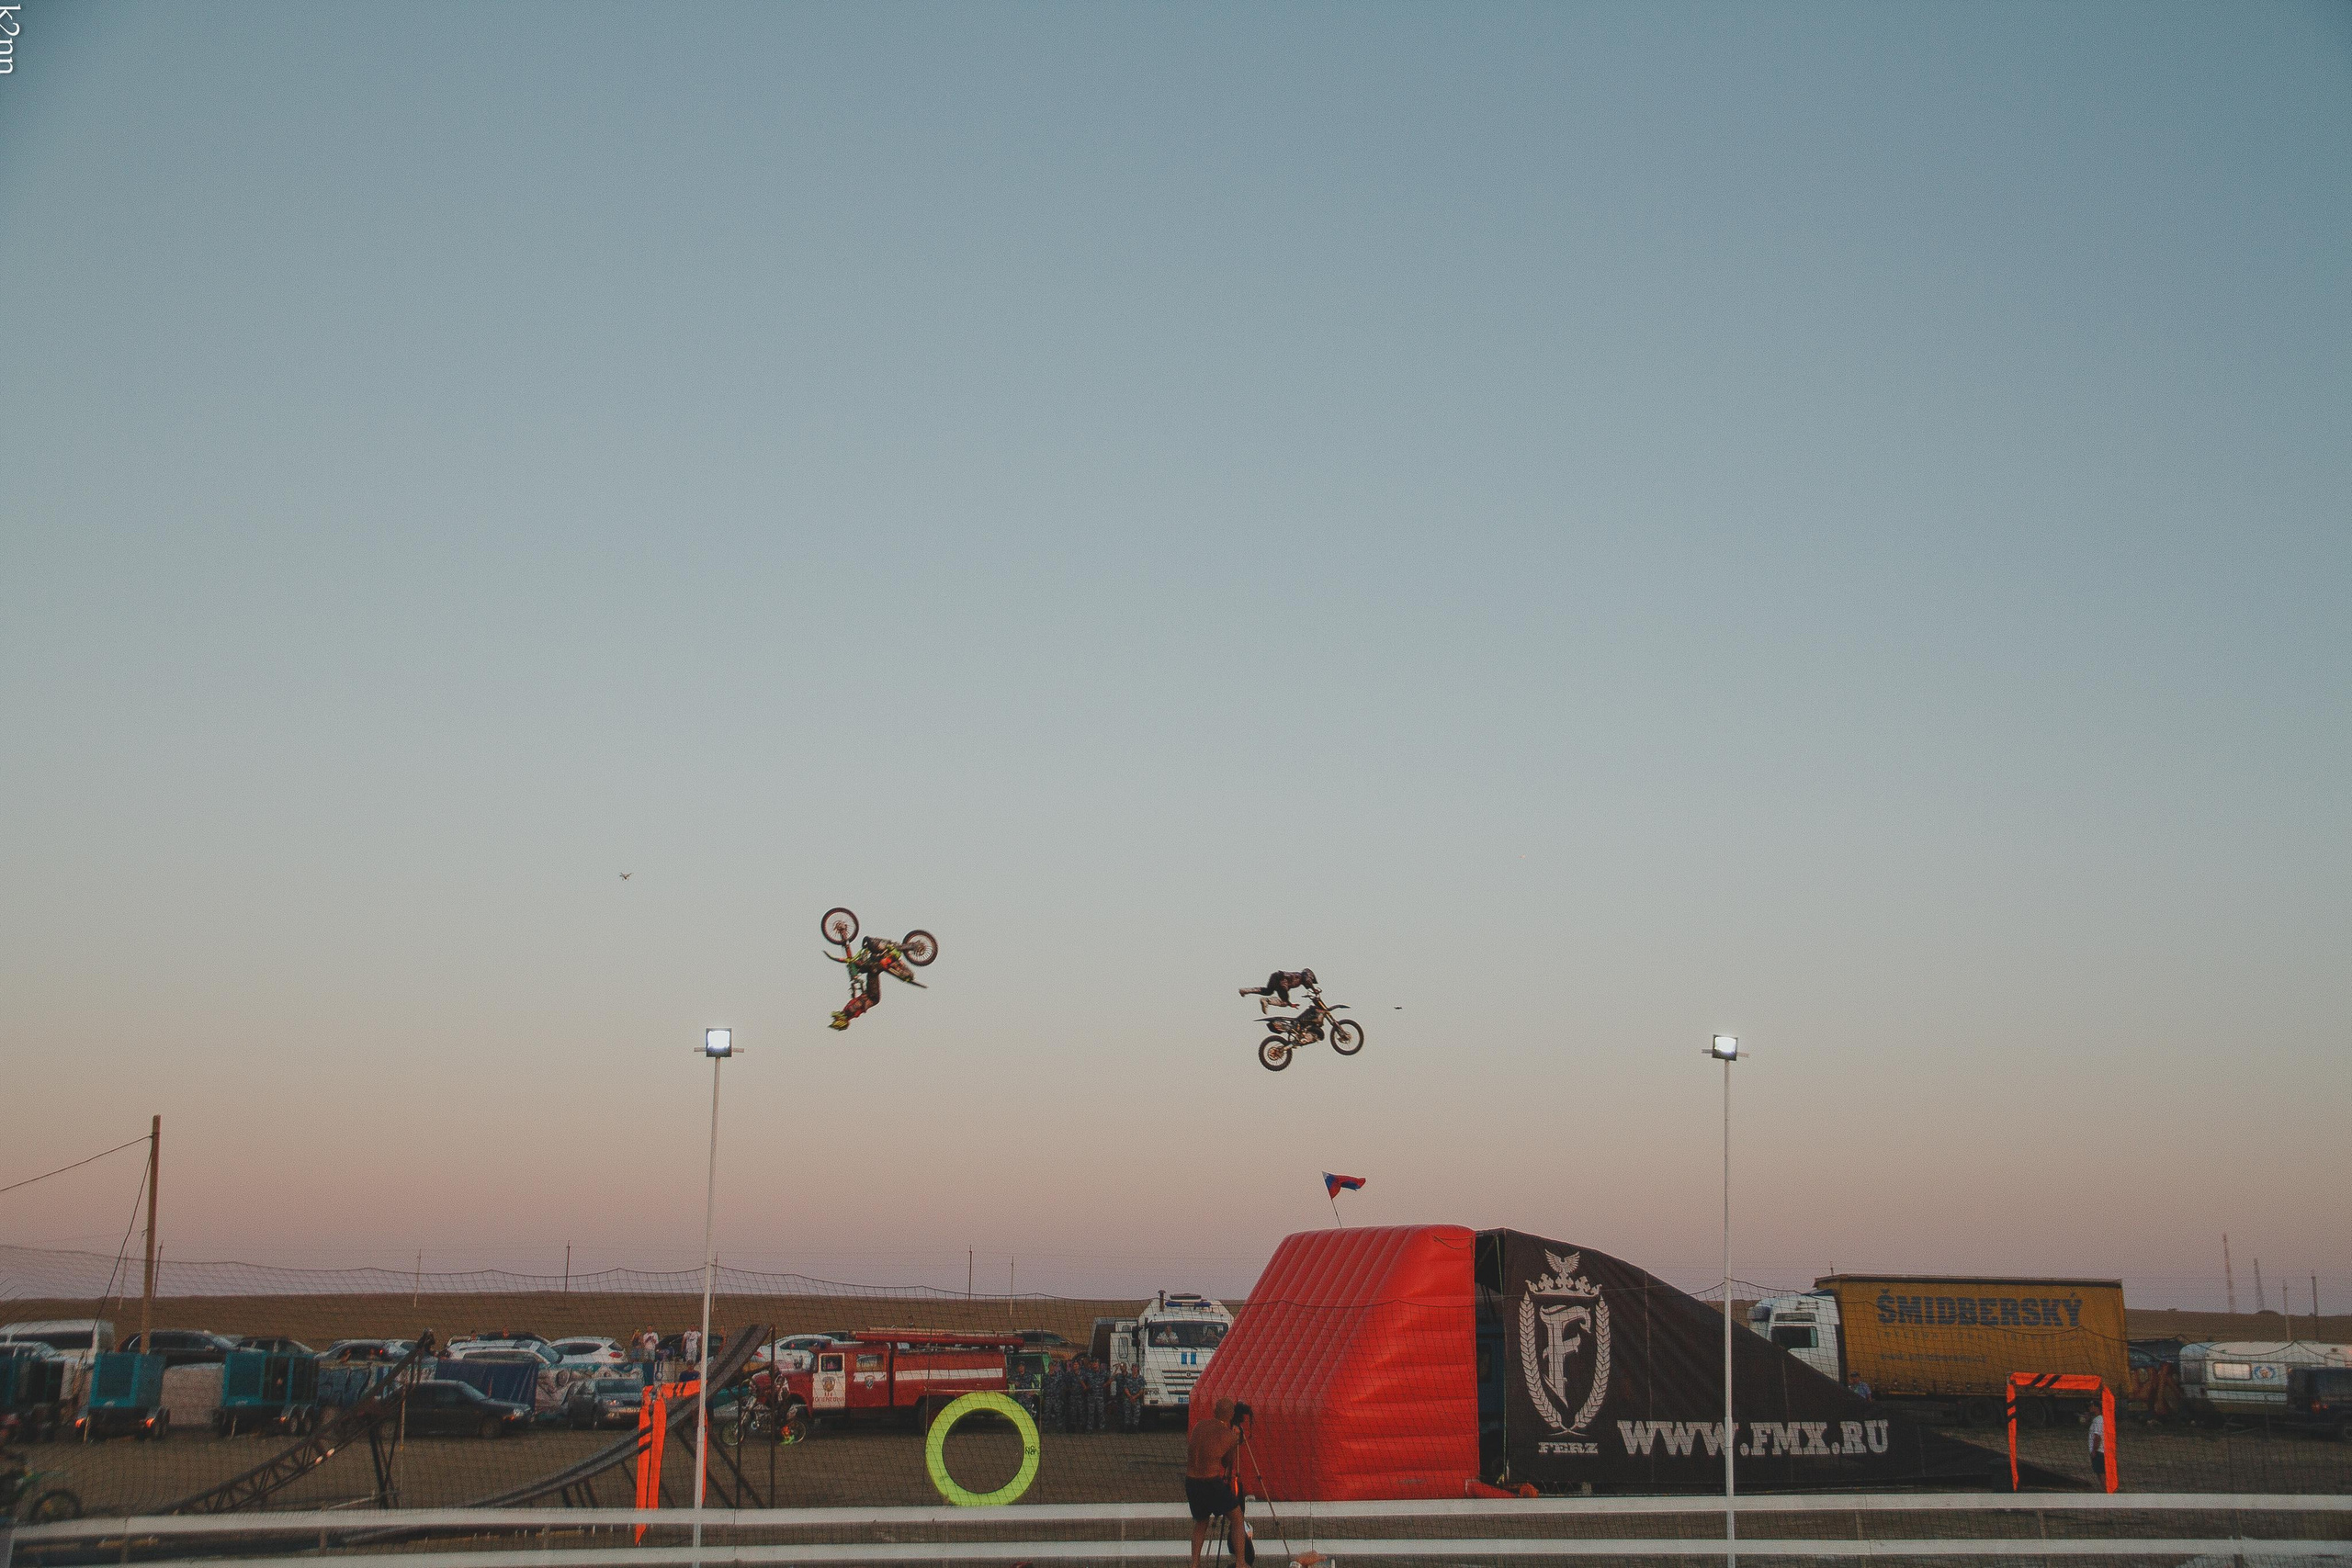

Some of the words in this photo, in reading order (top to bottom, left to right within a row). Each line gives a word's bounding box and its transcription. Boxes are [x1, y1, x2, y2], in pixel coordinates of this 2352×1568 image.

[1876, 1289, 2083, 1326] ŠMIDBERSKÝ
[1538, 1442, 1599, 1455] FERZ
[1617, 1419, 1888, 1456] WWW.FMX.RU
